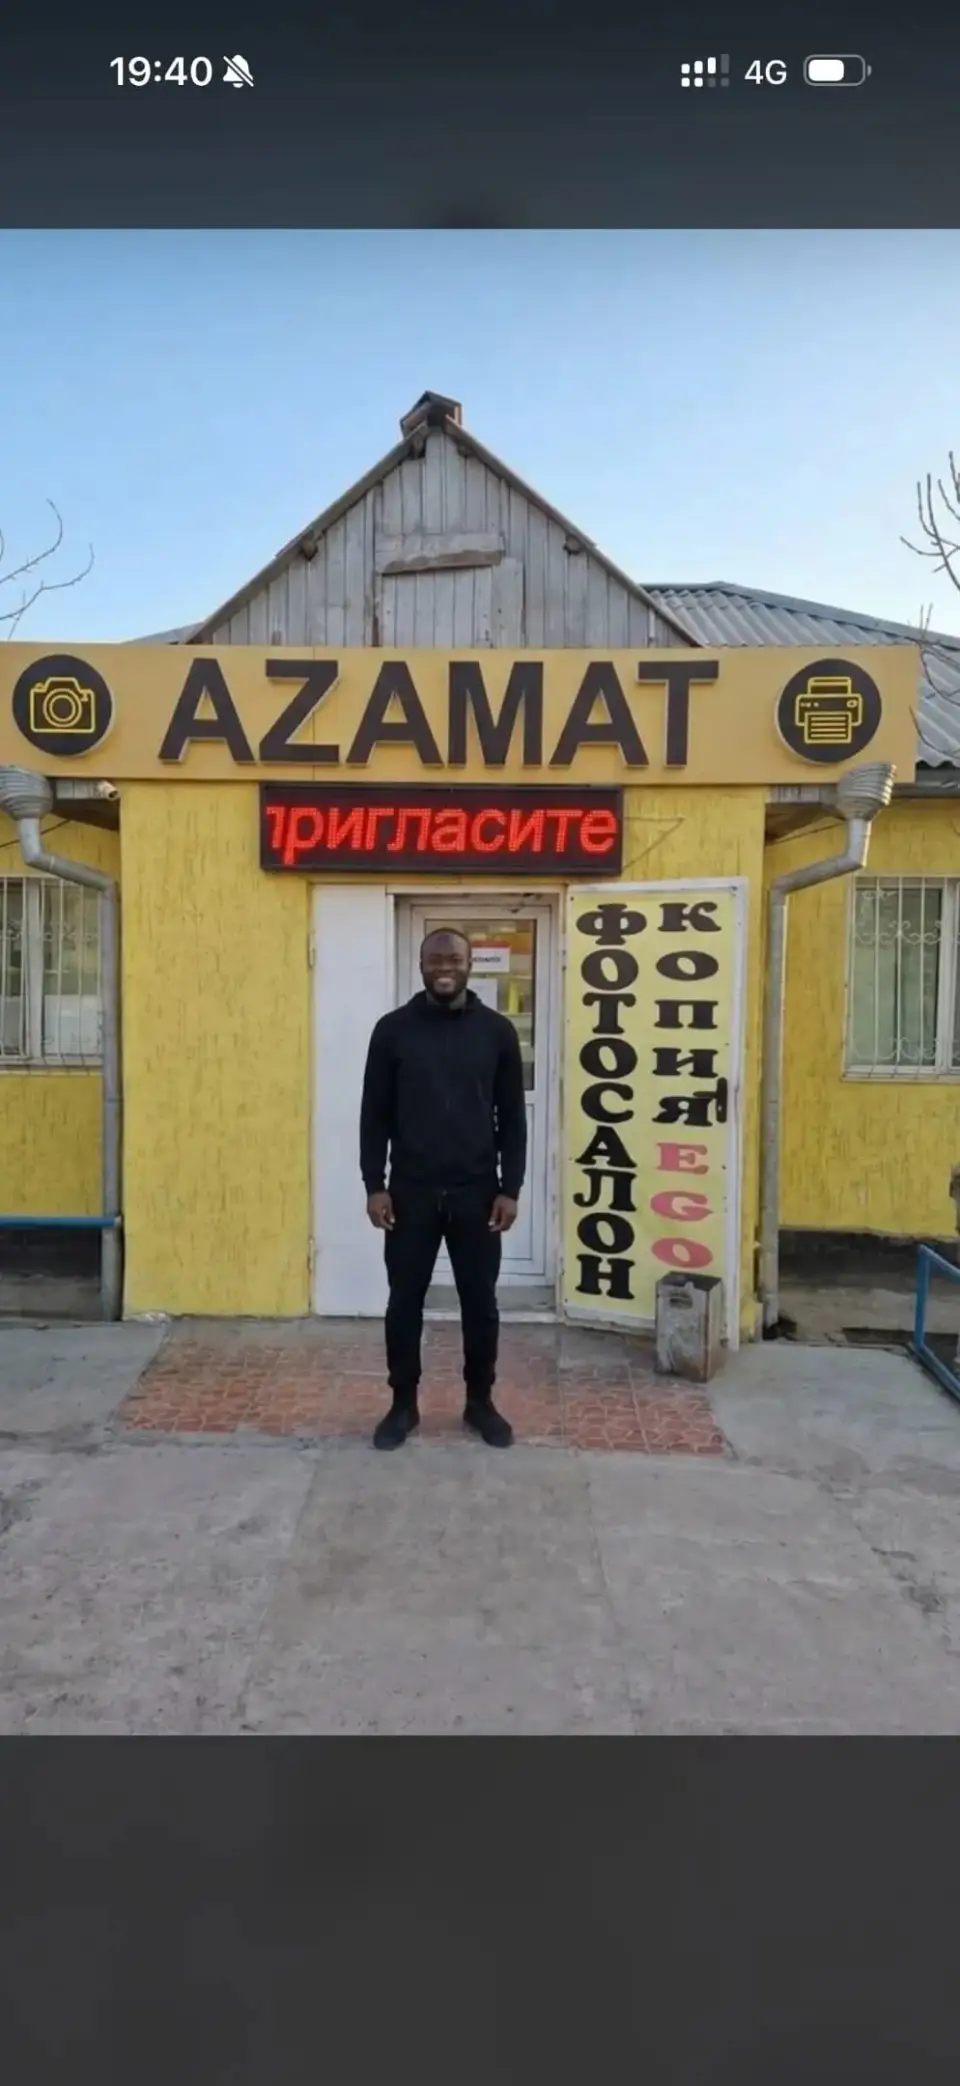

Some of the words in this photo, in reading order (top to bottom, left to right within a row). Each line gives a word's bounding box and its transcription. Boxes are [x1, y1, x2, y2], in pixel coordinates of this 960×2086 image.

[159, 659, 719, 766] AZAMAT
[574, 903, 647, 1300] ФОТОСАЛОН
[652, 902, 722, 1127] КОПИЯ
[650, 1142, 713, 1269] EGO
